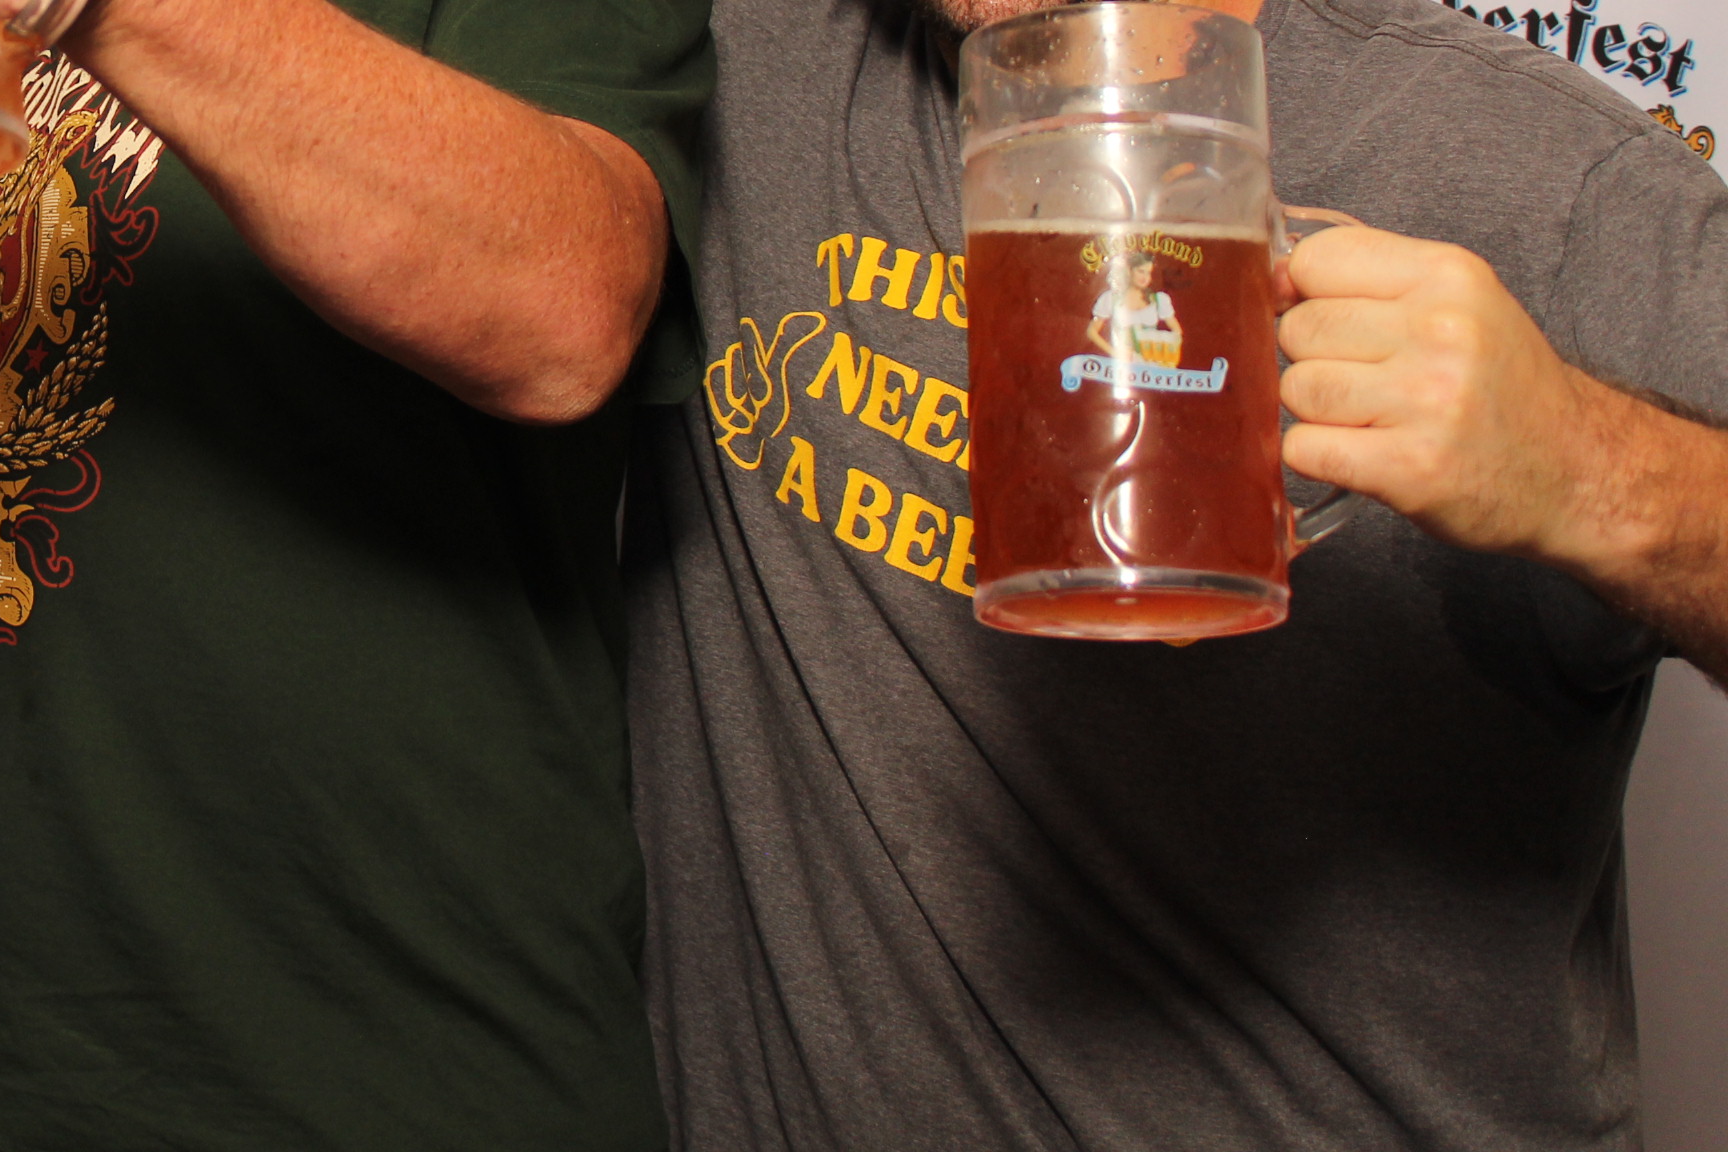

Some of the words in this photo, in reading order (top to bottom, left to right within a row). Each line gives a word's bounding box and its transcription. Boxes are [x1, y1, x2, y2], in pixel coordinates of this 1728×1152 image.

[816, 232, 969, 329] THIS
[806, 331, 970, 471] NEE
[1083, 357, 1213, 389] Okoberfest
[775, 435, 821, 524] A
